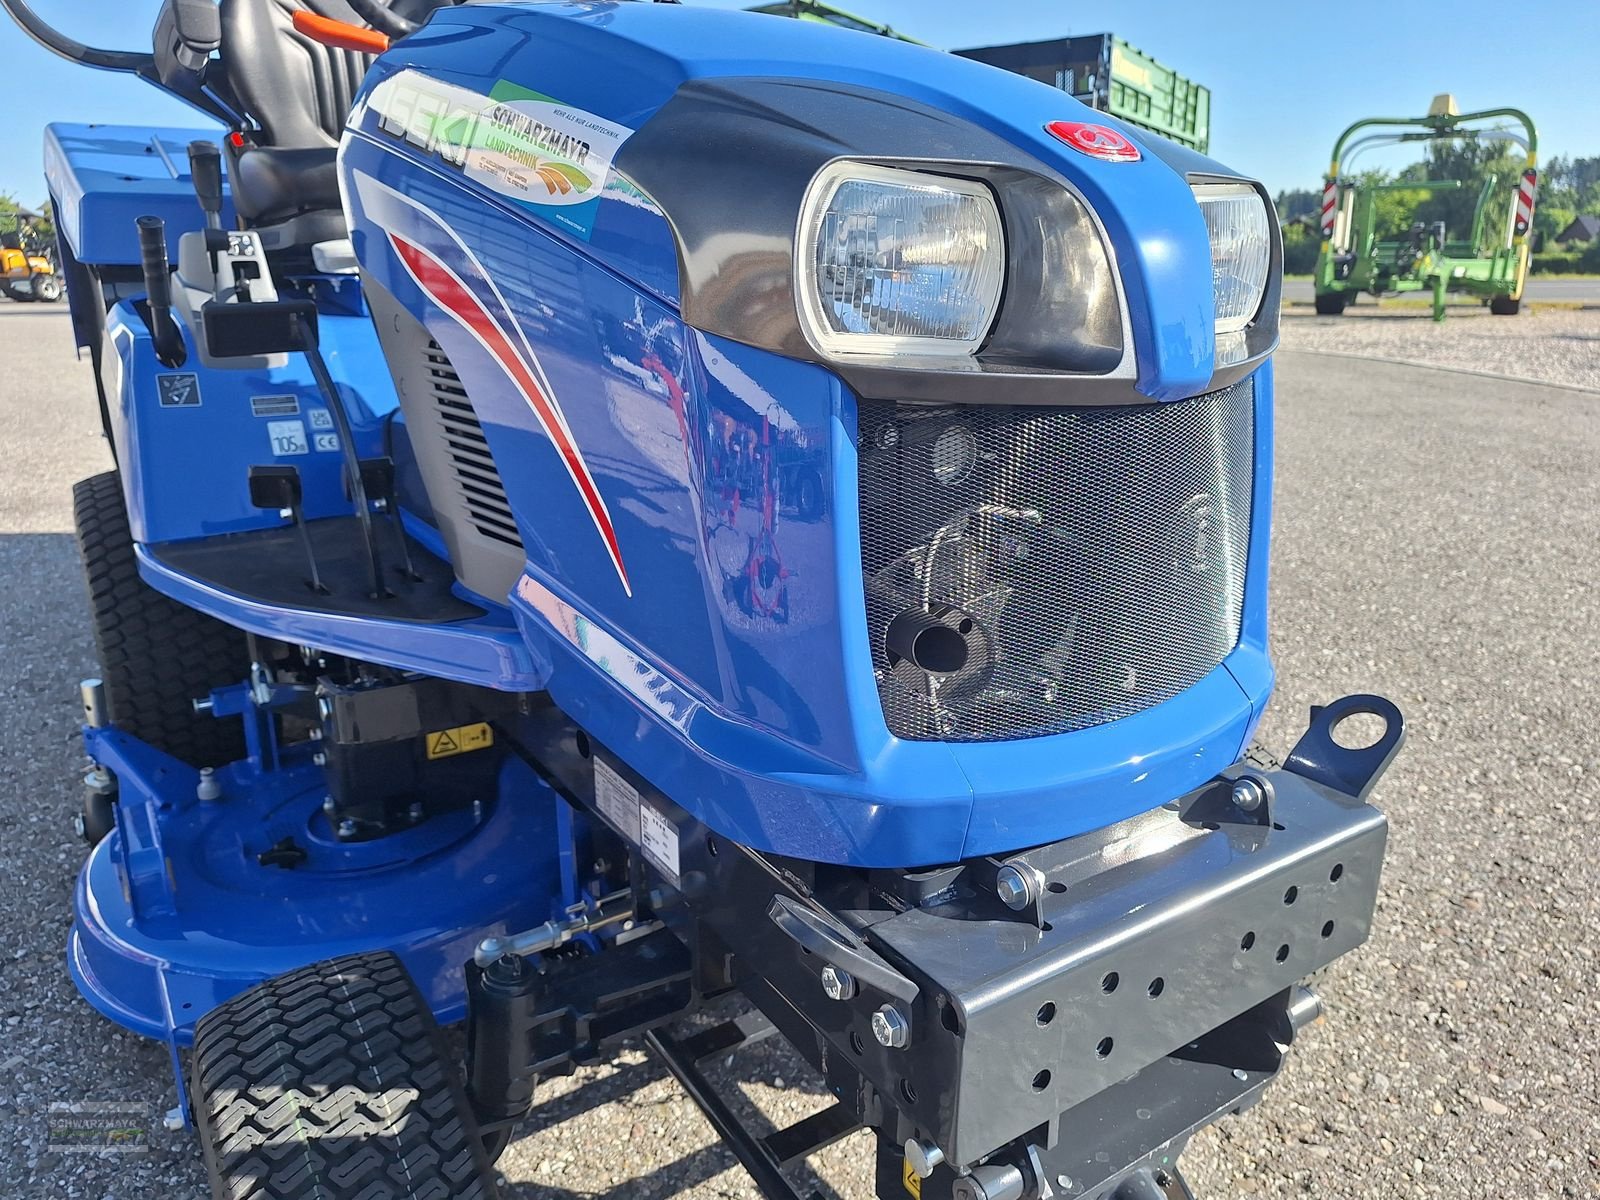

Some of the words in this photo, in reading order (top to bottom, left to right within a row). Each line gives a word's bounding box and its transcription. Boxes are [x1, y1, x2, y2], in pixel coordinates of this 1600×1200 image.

[377, 81, 479, 169] ISEKI
[490, 105, 591, 167] SCHWARZMAYR
[484, 133, 540, 171] LANDTECHNIK
[273, 435, 298, 453] 105
